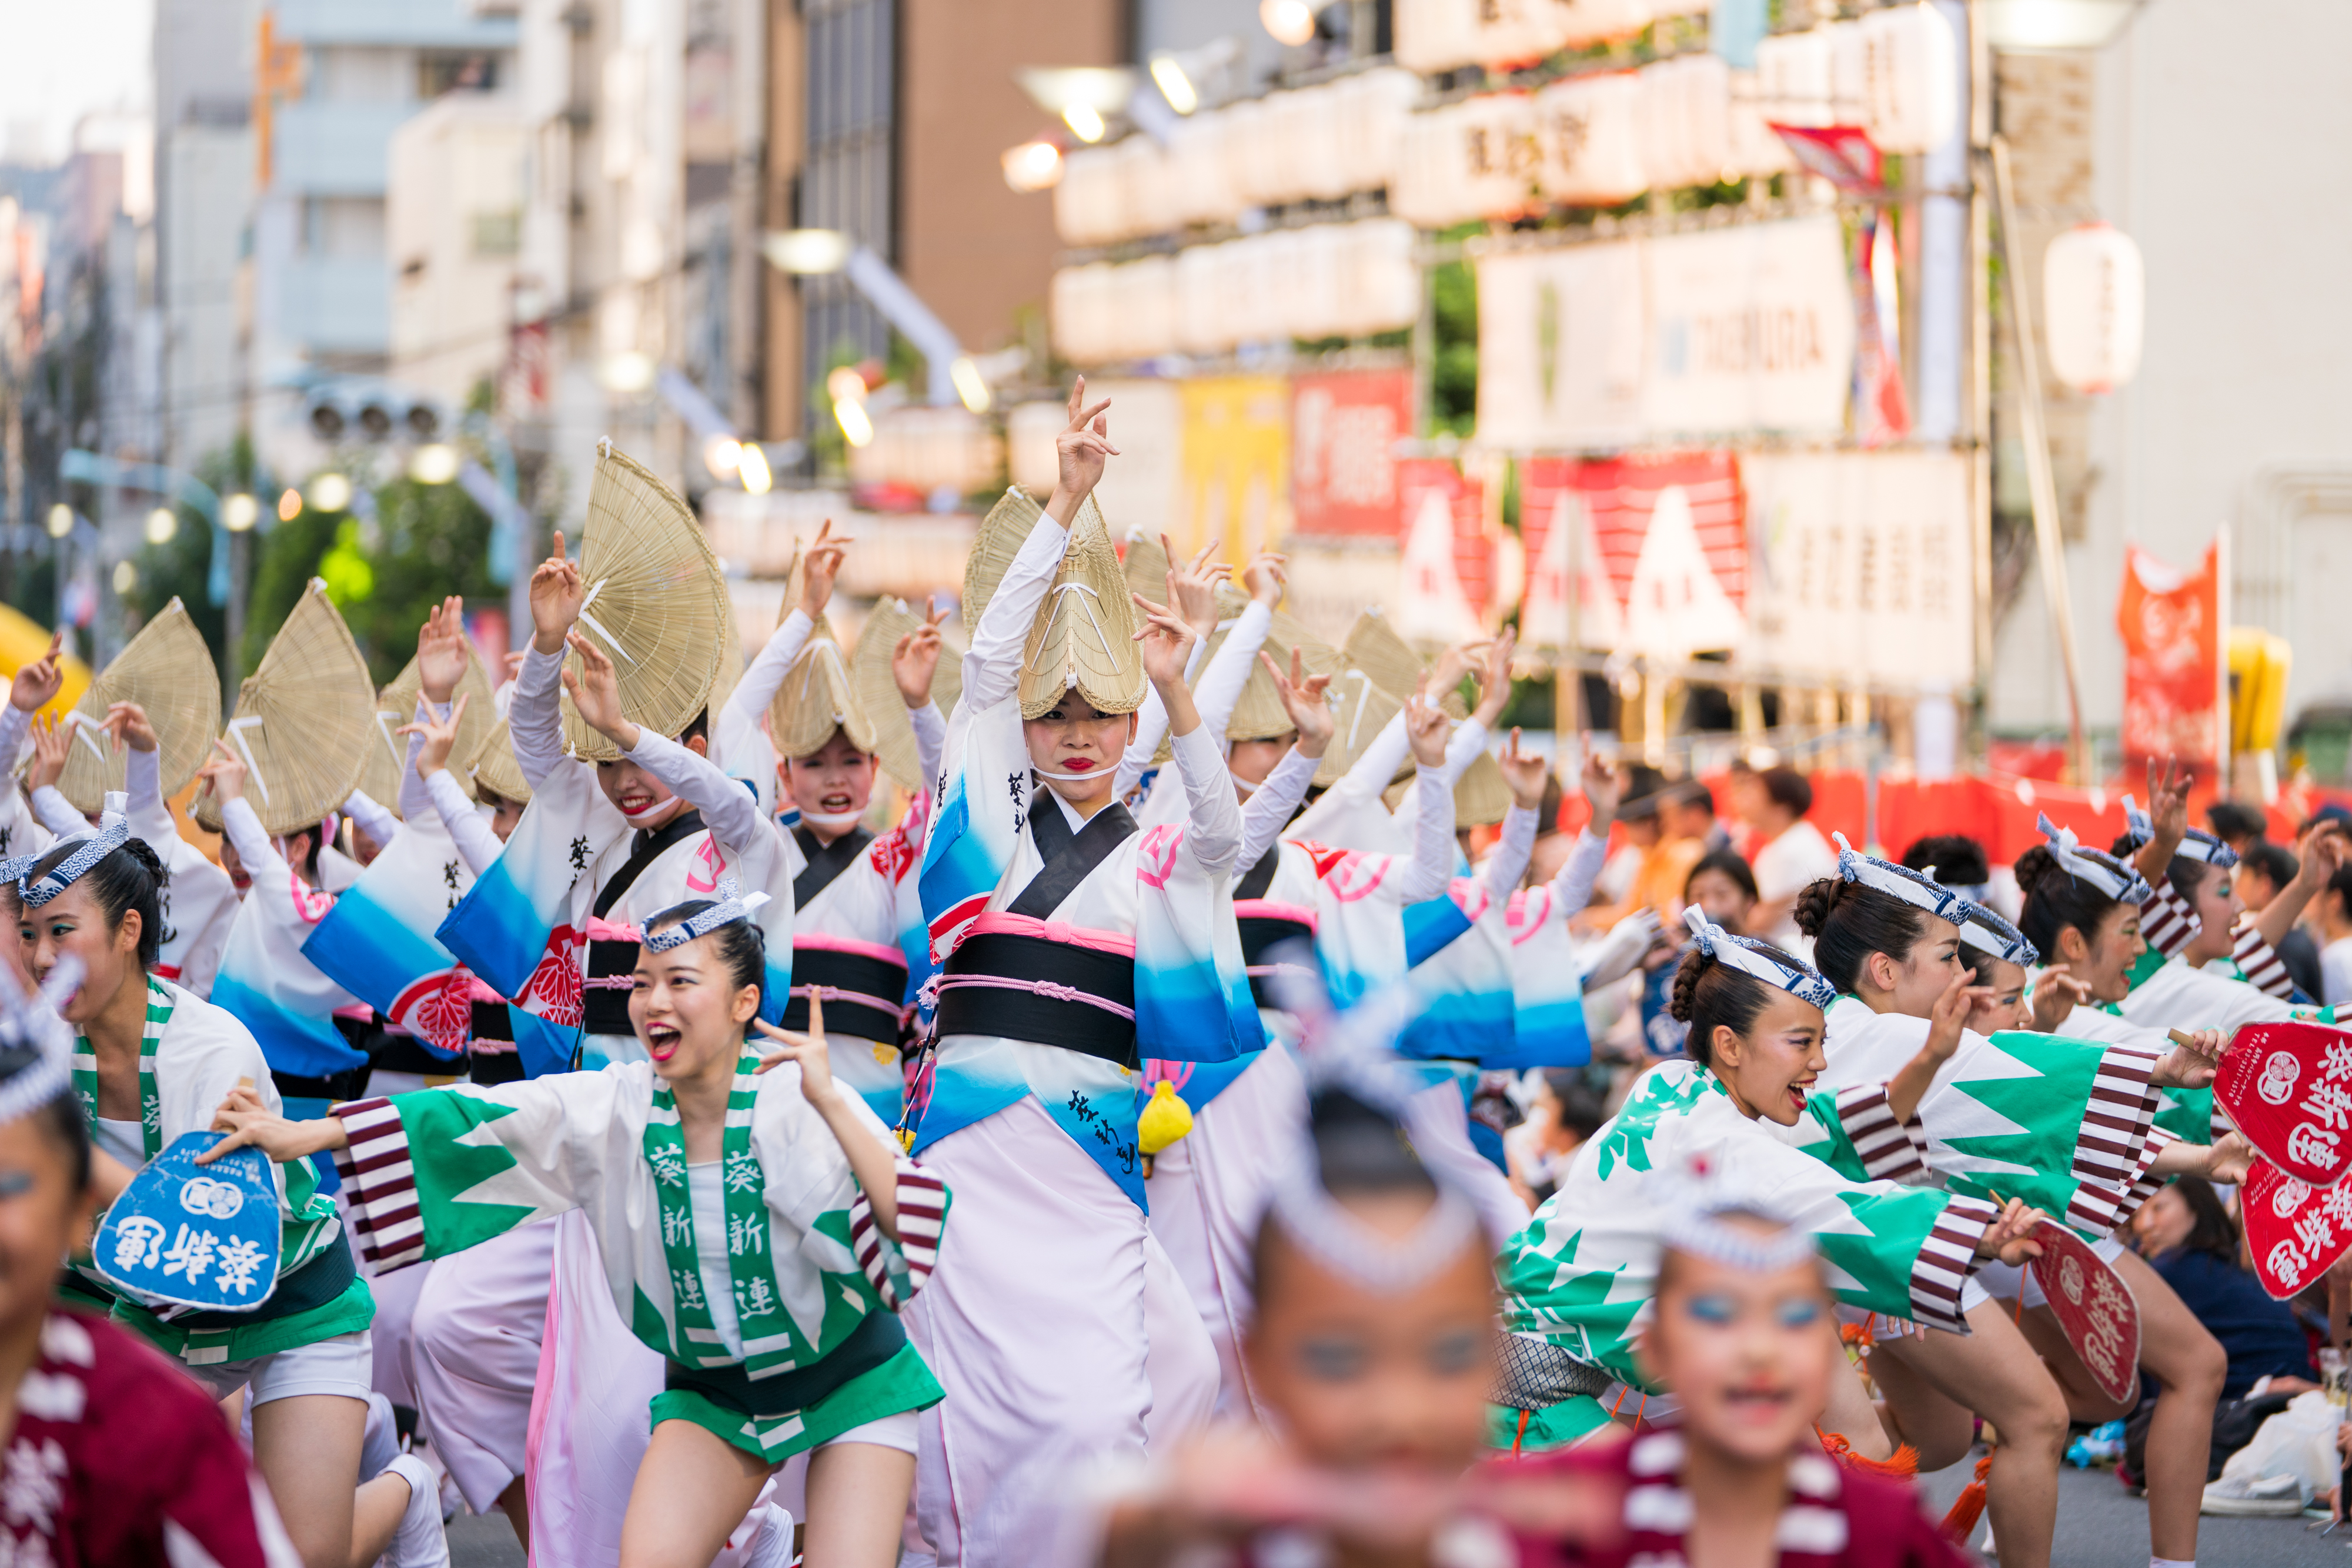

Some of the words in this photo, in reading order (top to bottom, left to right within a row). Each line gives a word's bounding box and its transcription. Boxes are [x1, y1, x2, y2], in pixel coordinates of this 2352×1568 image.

[113, 1215, 269, 1296] 葵新連
[650, 1144, 705, 1310] 葵新連
[724, 1150, 776, 1319] 葵新連
[2084, 1269, 2130, 1386] 葵新連
